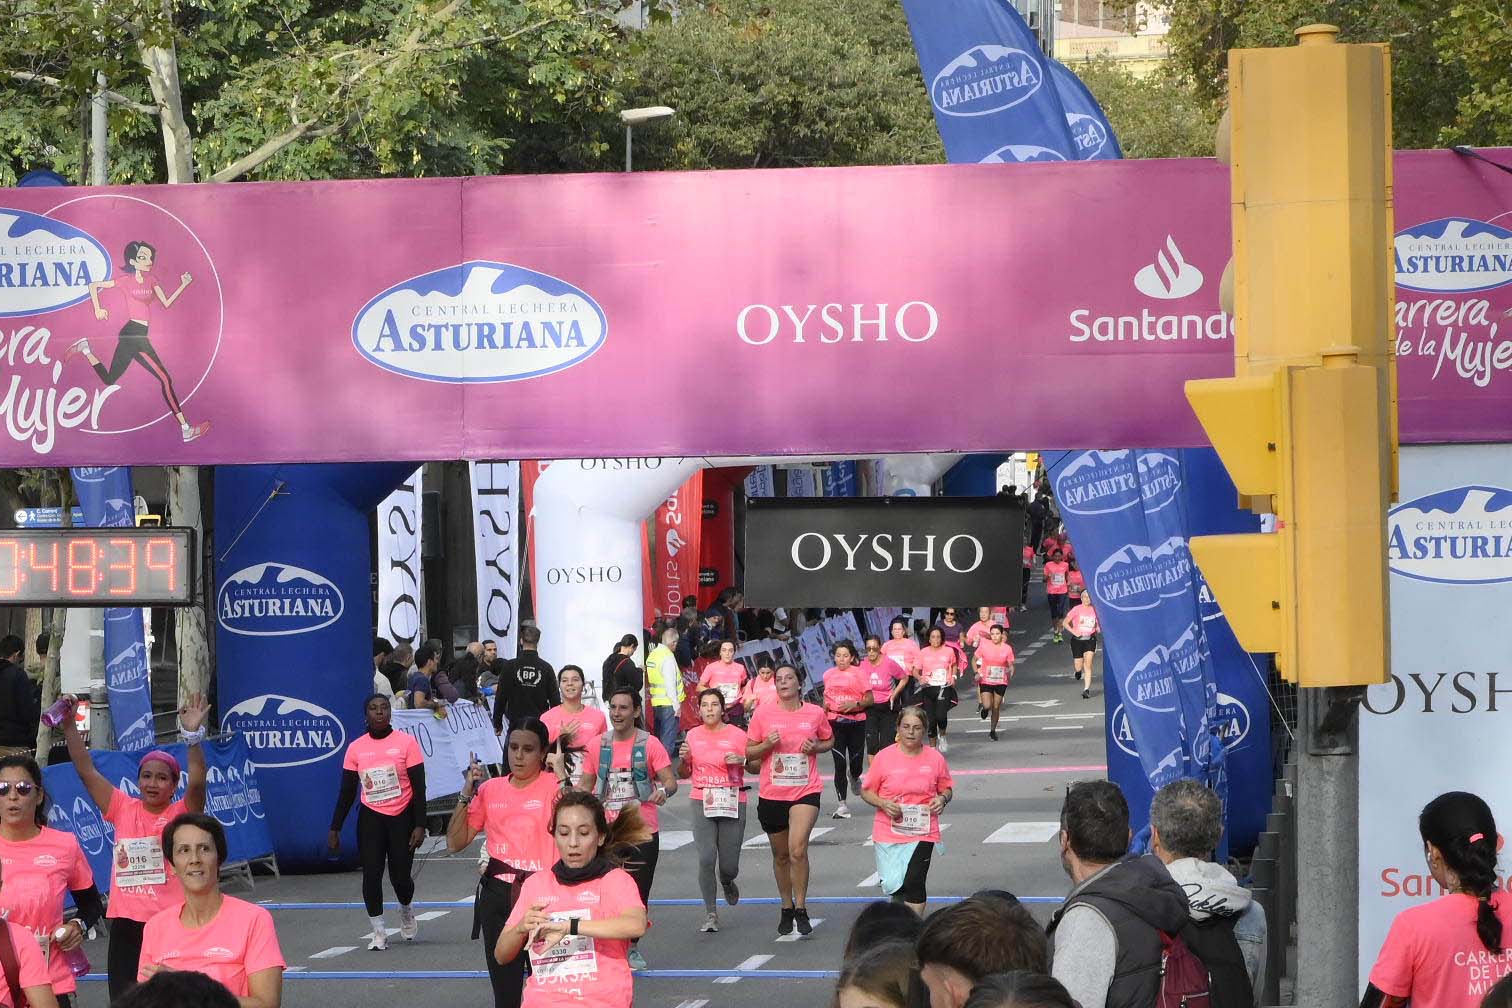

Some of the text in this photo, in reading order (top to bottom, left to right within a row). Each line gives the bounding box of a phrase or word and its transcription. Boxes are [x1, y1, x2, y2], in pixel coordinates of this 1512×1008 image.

[15, 244, 87, 256] LECHERA
[1408, 243, 1460, 251] CENTRAL
[1395, 246, 1512, 274] ASTURIAN
[411, 301, 579, 317] CENTRAL LECHERA
[1395, 299, 1490, 328] arrera
[372, 308, 587, 353] ASTURIANA
[736, 301, 939, 346] OYSHO
[1418, 329, 1436, 356] la
[580, 457, 662, 470] OYSHO
[1415, 521, 1484, 531] CENTRAL
[791, 532, 984, 573] OYSHO
[546, 565, 622, 584] OYSHO
[282, 587, 330, 595] LECHERA
[222, 592, 335, 619] ASTURIANA
[522, 670, 536, 680] BP
[282, 719, 331, 727] LECHERA
[232, 727, 336, 748] TURIANA
[129, 856, 147, 864] 016
[1469, 965, 1490, 980] DE
